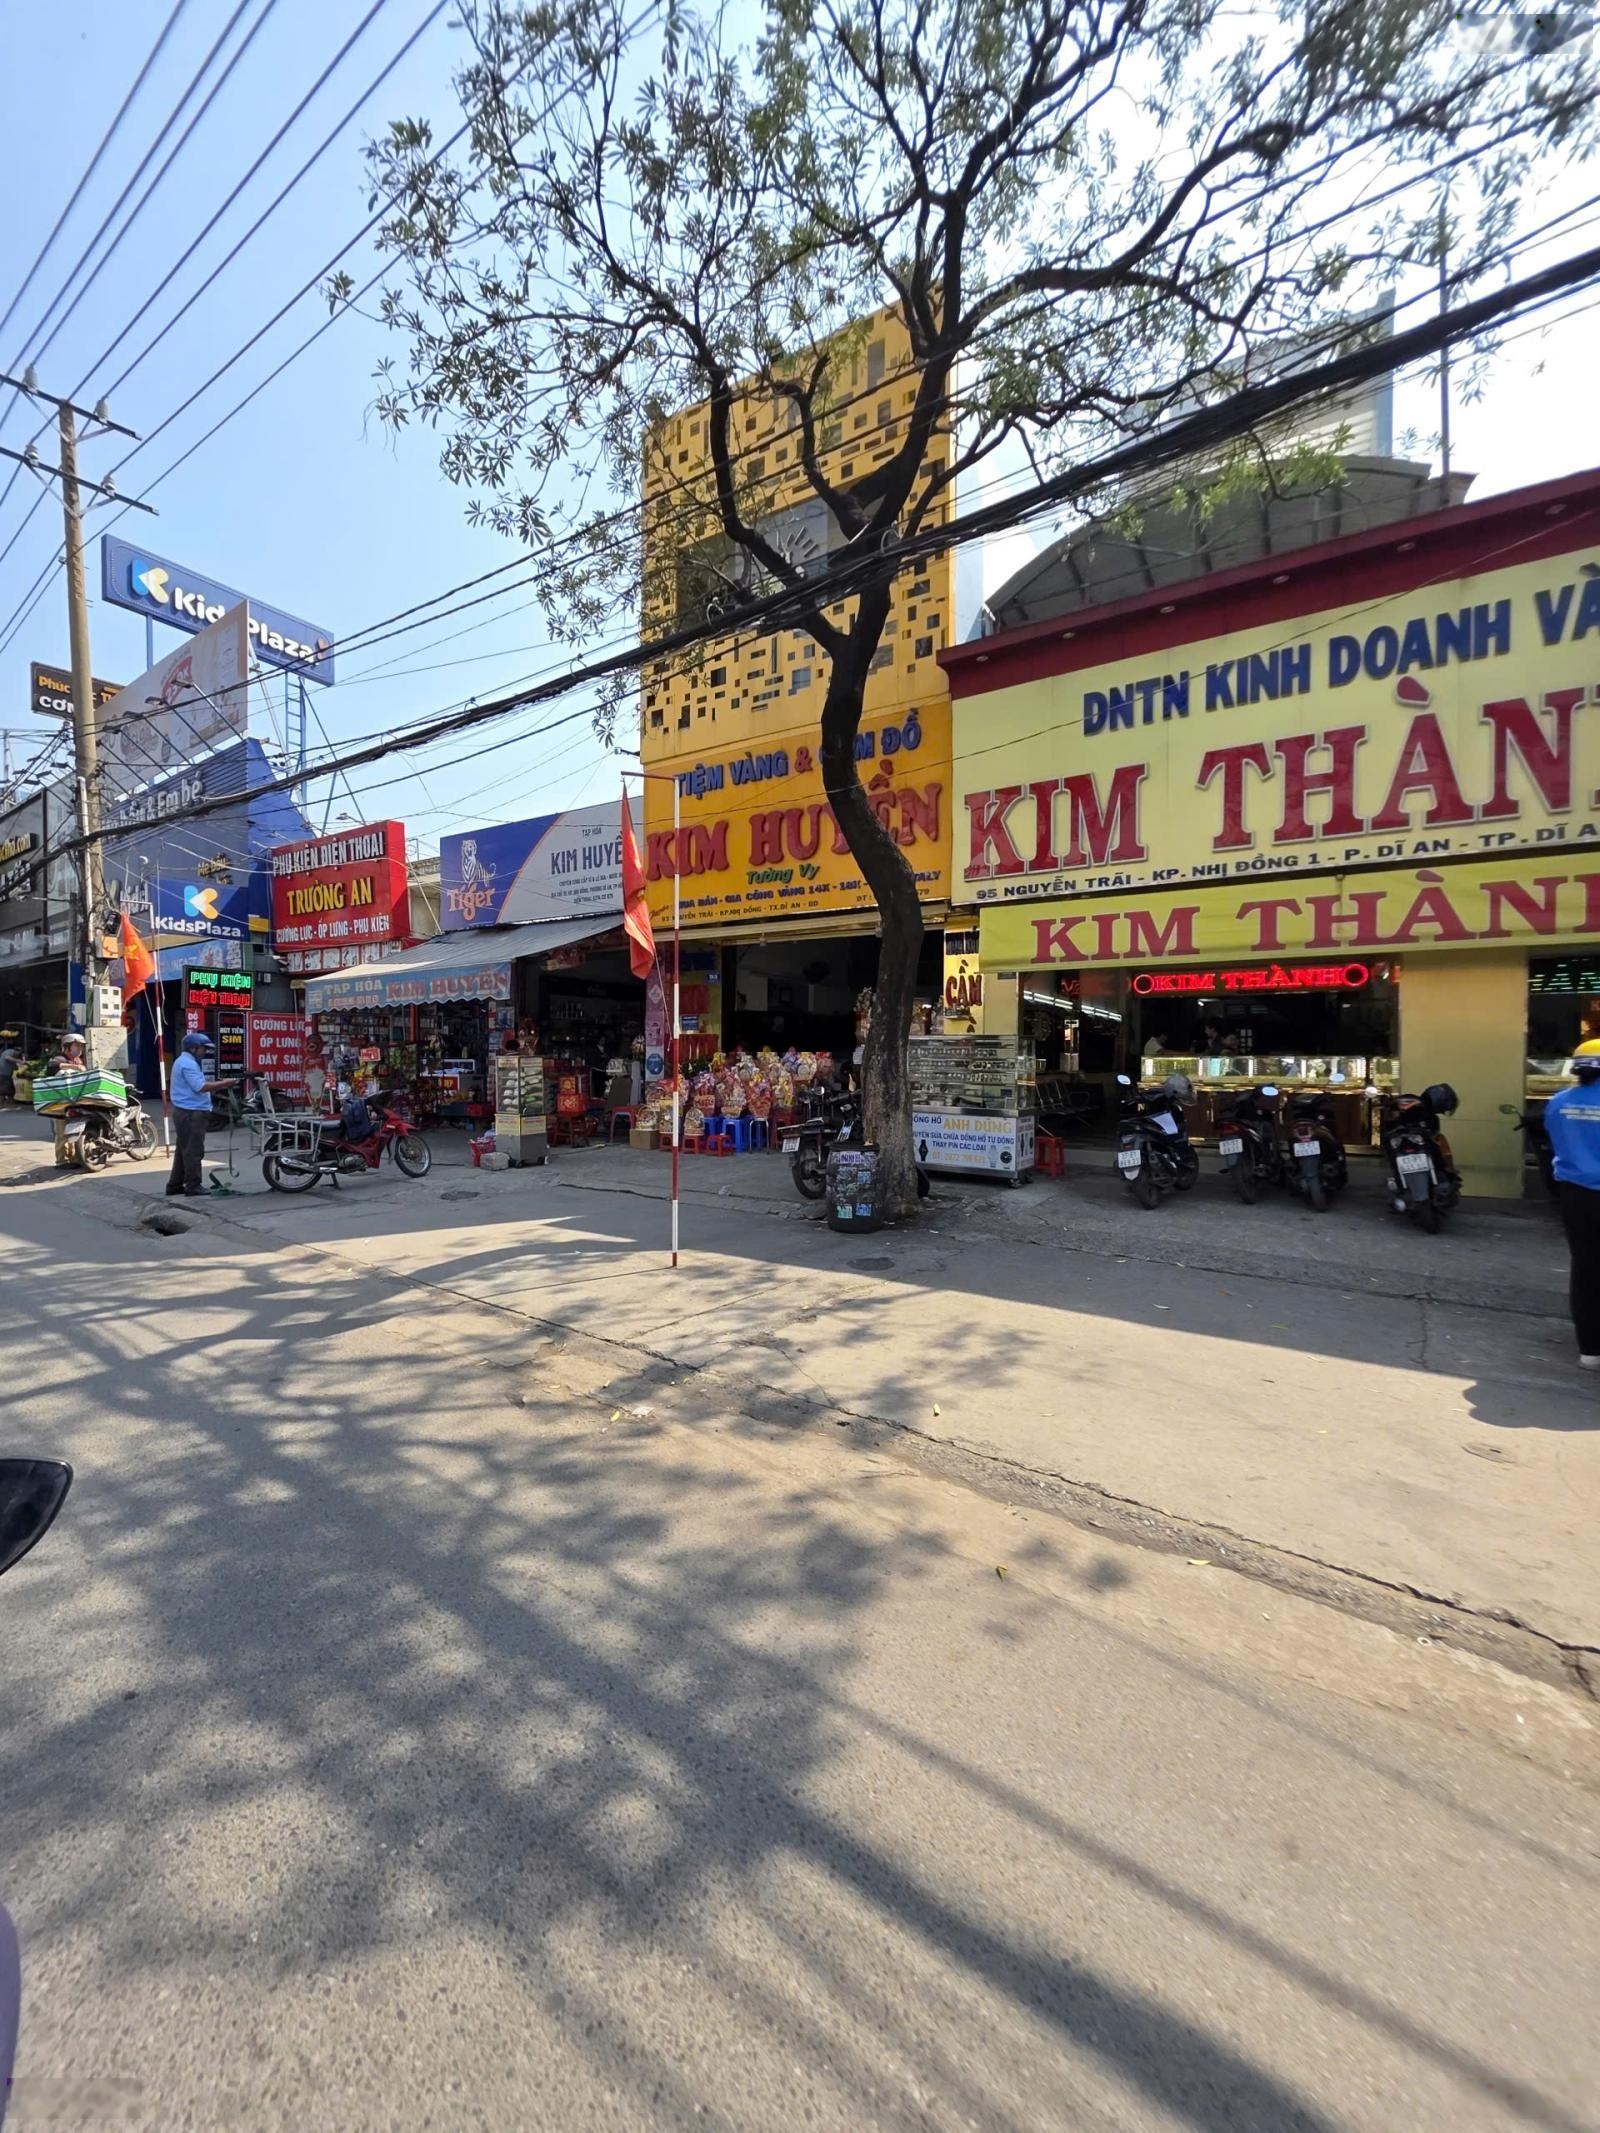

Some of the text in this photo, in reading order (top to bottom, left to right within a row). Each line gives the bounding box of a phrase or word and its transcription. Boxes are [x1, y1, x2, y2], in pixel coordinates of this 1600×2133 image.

[1083, 670, 1190, 736] DNTN
[1205, 643, 1311, 712] KINH
[1328, 598, 1511, 689] DOANH
[676, 763, 724, 800] TIỆM
[729, 750, 790, 788] VÀNG
[794, 746, 813, 774] &
[963, 675, 1600, 882] KIM THÀN
[293, 843, 319, 876] KIỆN
[551, 830, 623, 875] KIM HUYỀ
[645, 820, 729, 881] KIM
[976, 888, 997, 900] 95
[1004, 875, 1077, 898] NGUYỄN
[1084, 871, 1132, 889] TRÃI
[1192, 863, 1228, 878] NHỊ
[1235, 853, 1298, 873] ĐỒNG
[1308, 852, 1320, 865] 1
[1377, 839, 1407, 858] DĨ
[1412, 838, 1450, 854] AN
[1536, 822, 1569, 841] DĨ
[287, 876, 373, 915] TRƯỜNG AN
[447, 883, 496, 920] Tiger
[746, 889, 774, 901] CÔNG
[779, 885, 805, 898] VÀNG
[155, 916, 241, 937] KidsPlaza
[354, 919, 369, 937] PHỤ
[371, 912, 390, 935] KIỆN
[1030, 905, 1200, 964] KIM
[190, 971, 251, 990] PHỤ KIỆN
[386, 968, 508, 1000] KIM HUYỀN
[1153, 963, 1344, 991] KIM THÀNH
[222, 1035, 242, 1044] SIM
[253, 1018, 287, 1031] CƯỜNG
[260, 1033, 302, 1048] ỐP LƯNG
[913, 1113, 929, 1124] ỒNG
